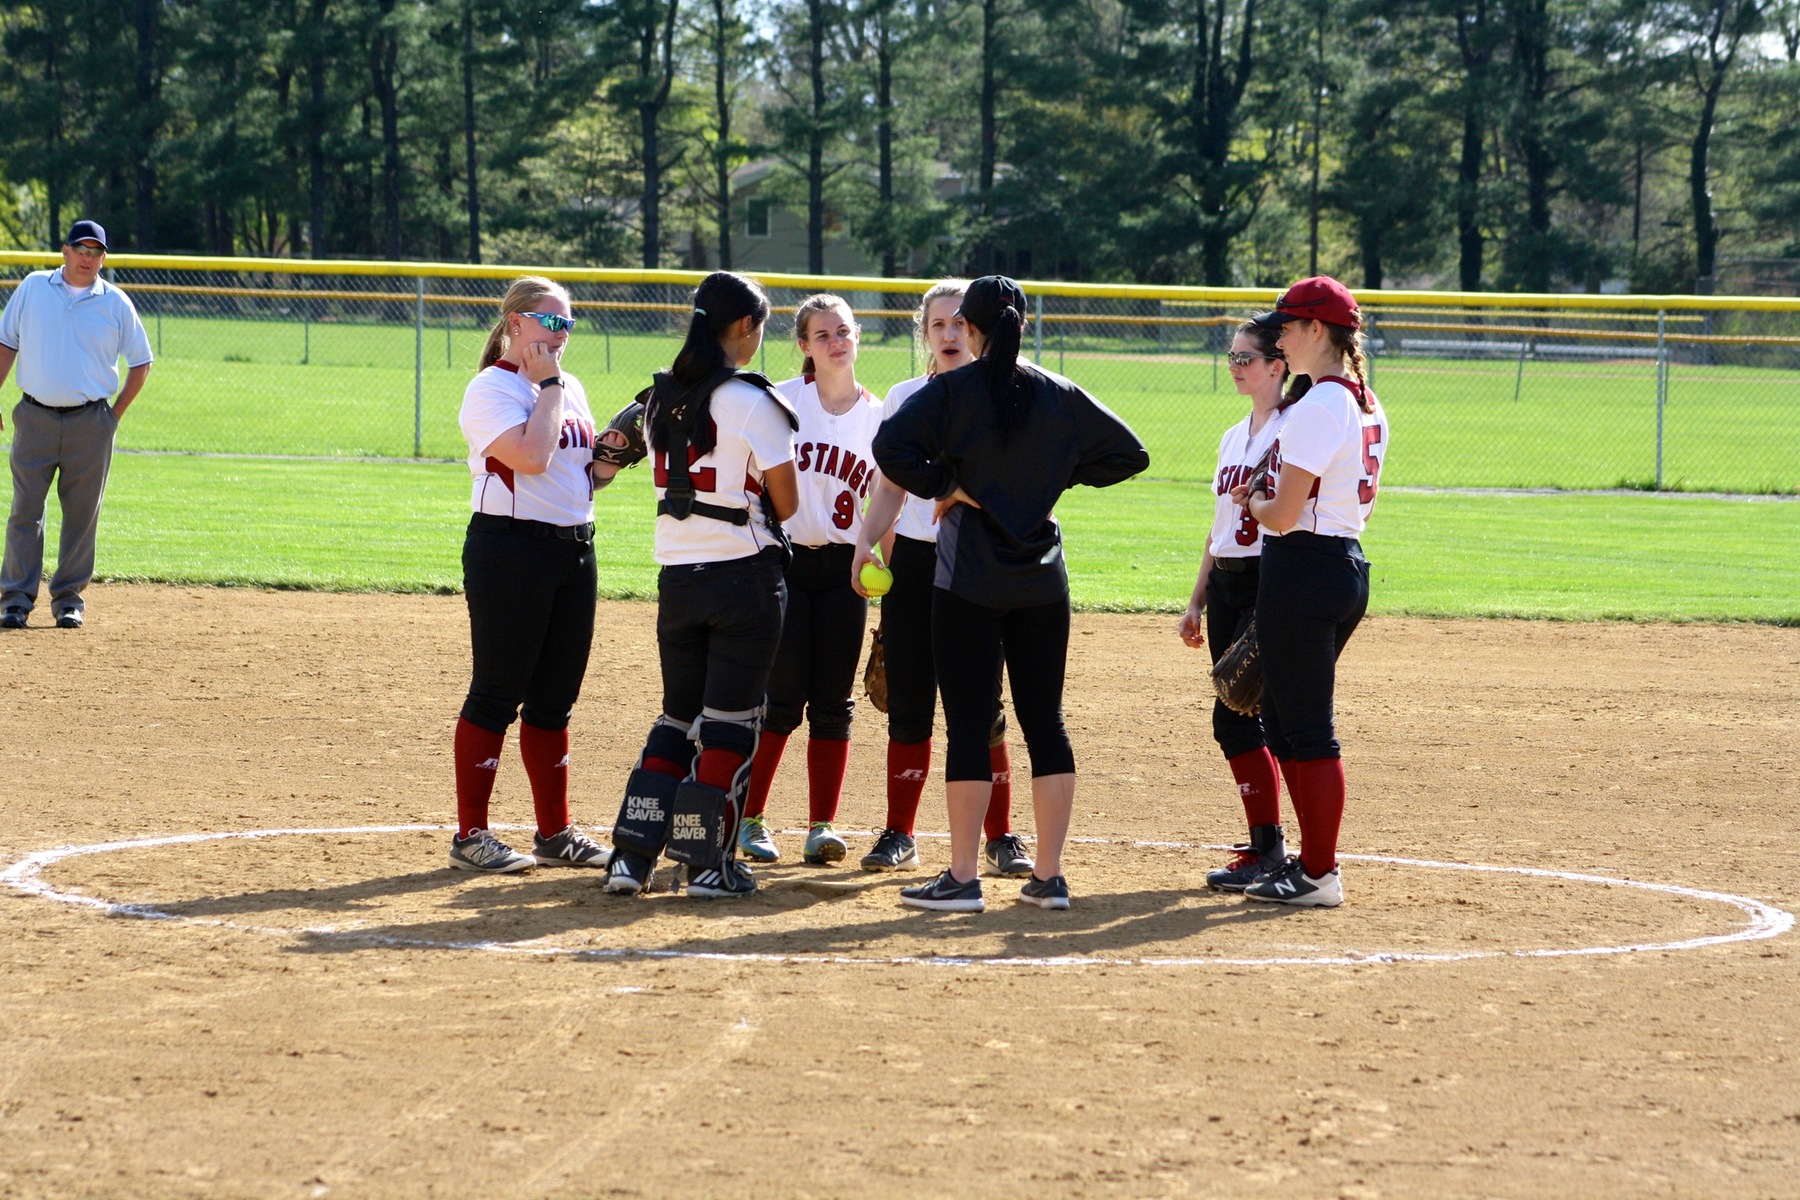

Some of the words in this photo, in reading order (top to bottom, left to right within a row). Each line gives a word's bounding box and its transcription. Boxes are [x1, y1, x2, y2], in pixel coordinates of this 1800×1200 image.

[794, 441, 875, 499] STANGS
[1357, 424, 1382, 505] 5
[831, 489, 855, 531] 9
[1234, 506, 1260, 547] 3
[625, 807, 666, 822] SAVER
[627, 796, 660, 810] KNEE
[672, 826, 707, 840] SAVER
[673, 813, 702, 828] KNEE
